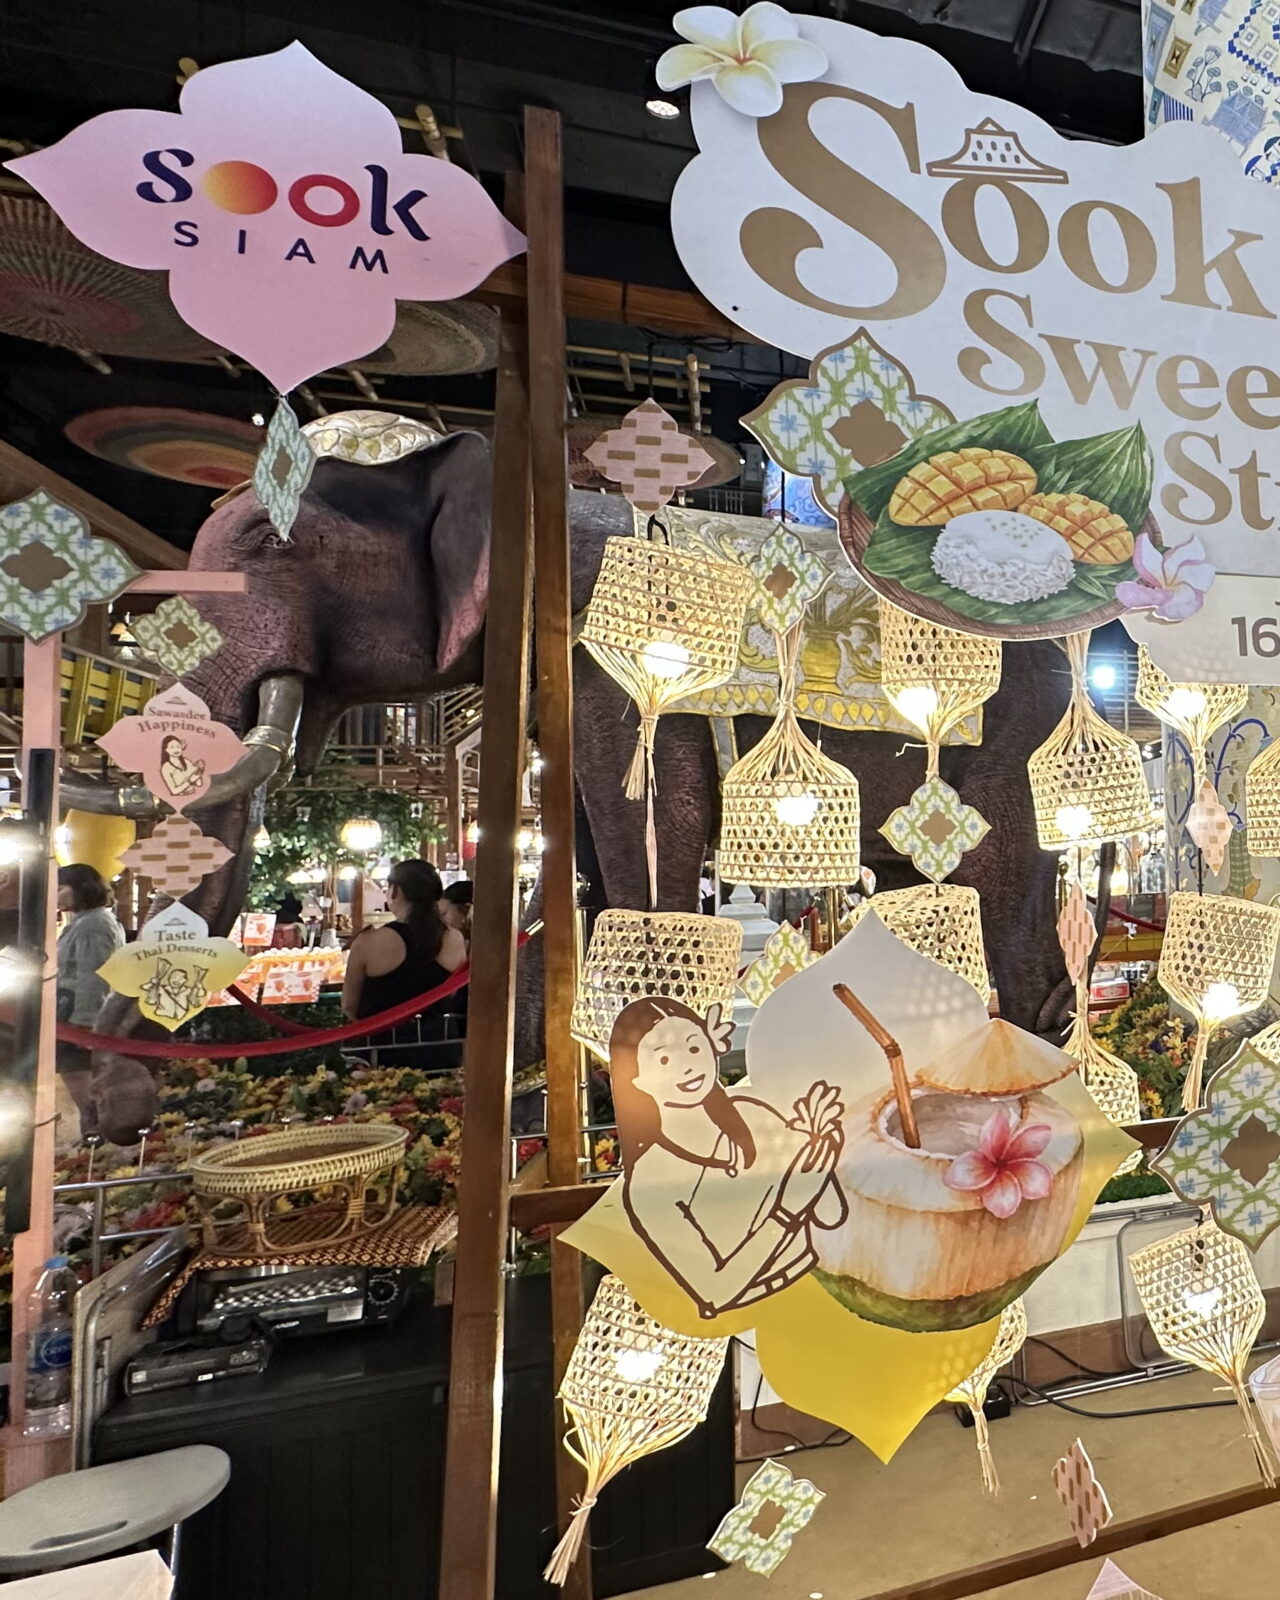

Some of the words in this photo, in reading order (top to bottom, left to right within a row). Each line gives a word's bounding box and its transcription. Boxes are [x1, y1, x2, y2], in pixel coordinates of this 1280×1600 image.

[740, 81, 1277, 321] Sook
[173, 219, 390, 274] SIAM
[148, 706, 207, 720] Sawasdee
[137, 720, 216, 738] Happiness
[154, 929, 197, 942] Taste
[131, 945, 162, 961] Thai
[166, 943, 219, 958] Desserts
